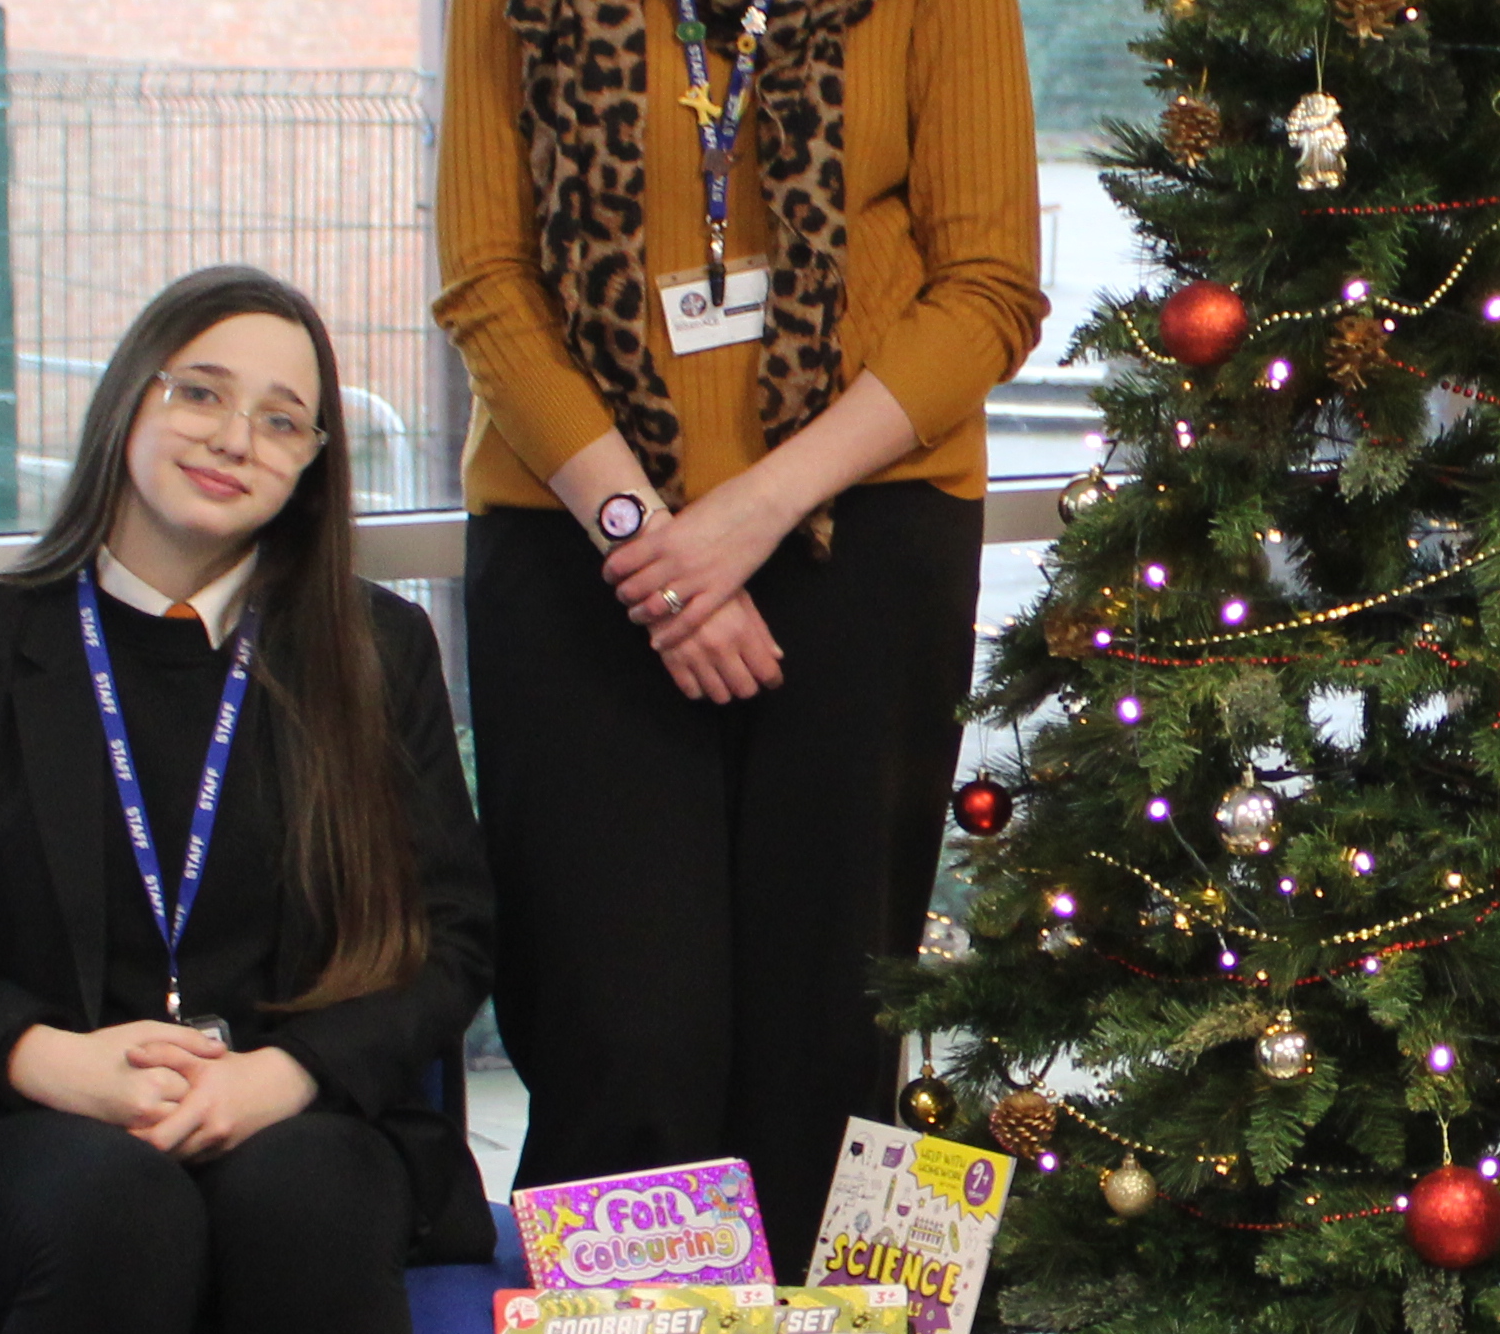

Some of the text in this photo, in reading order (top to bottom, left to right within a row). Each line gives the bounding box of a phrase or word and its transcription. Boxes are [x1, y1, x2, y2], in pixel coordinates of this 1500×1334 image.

[215, 701, 237, 745] STAFF
[110, 738, 133, 782] STAFF
[198, 766, 221, 811] STAFF
[124, 805, 150, 851] STAFF
[183, 833, 206, 881] STAFF
[573, 1227, 736, 1273] Colouring
[826, 1233, 962, 1305] SCIENCE
[742, 1291, 764, 1304] 3+
[875, 1291, 898, 1305] 3+
[787, 1307, 838, 1334] SET
